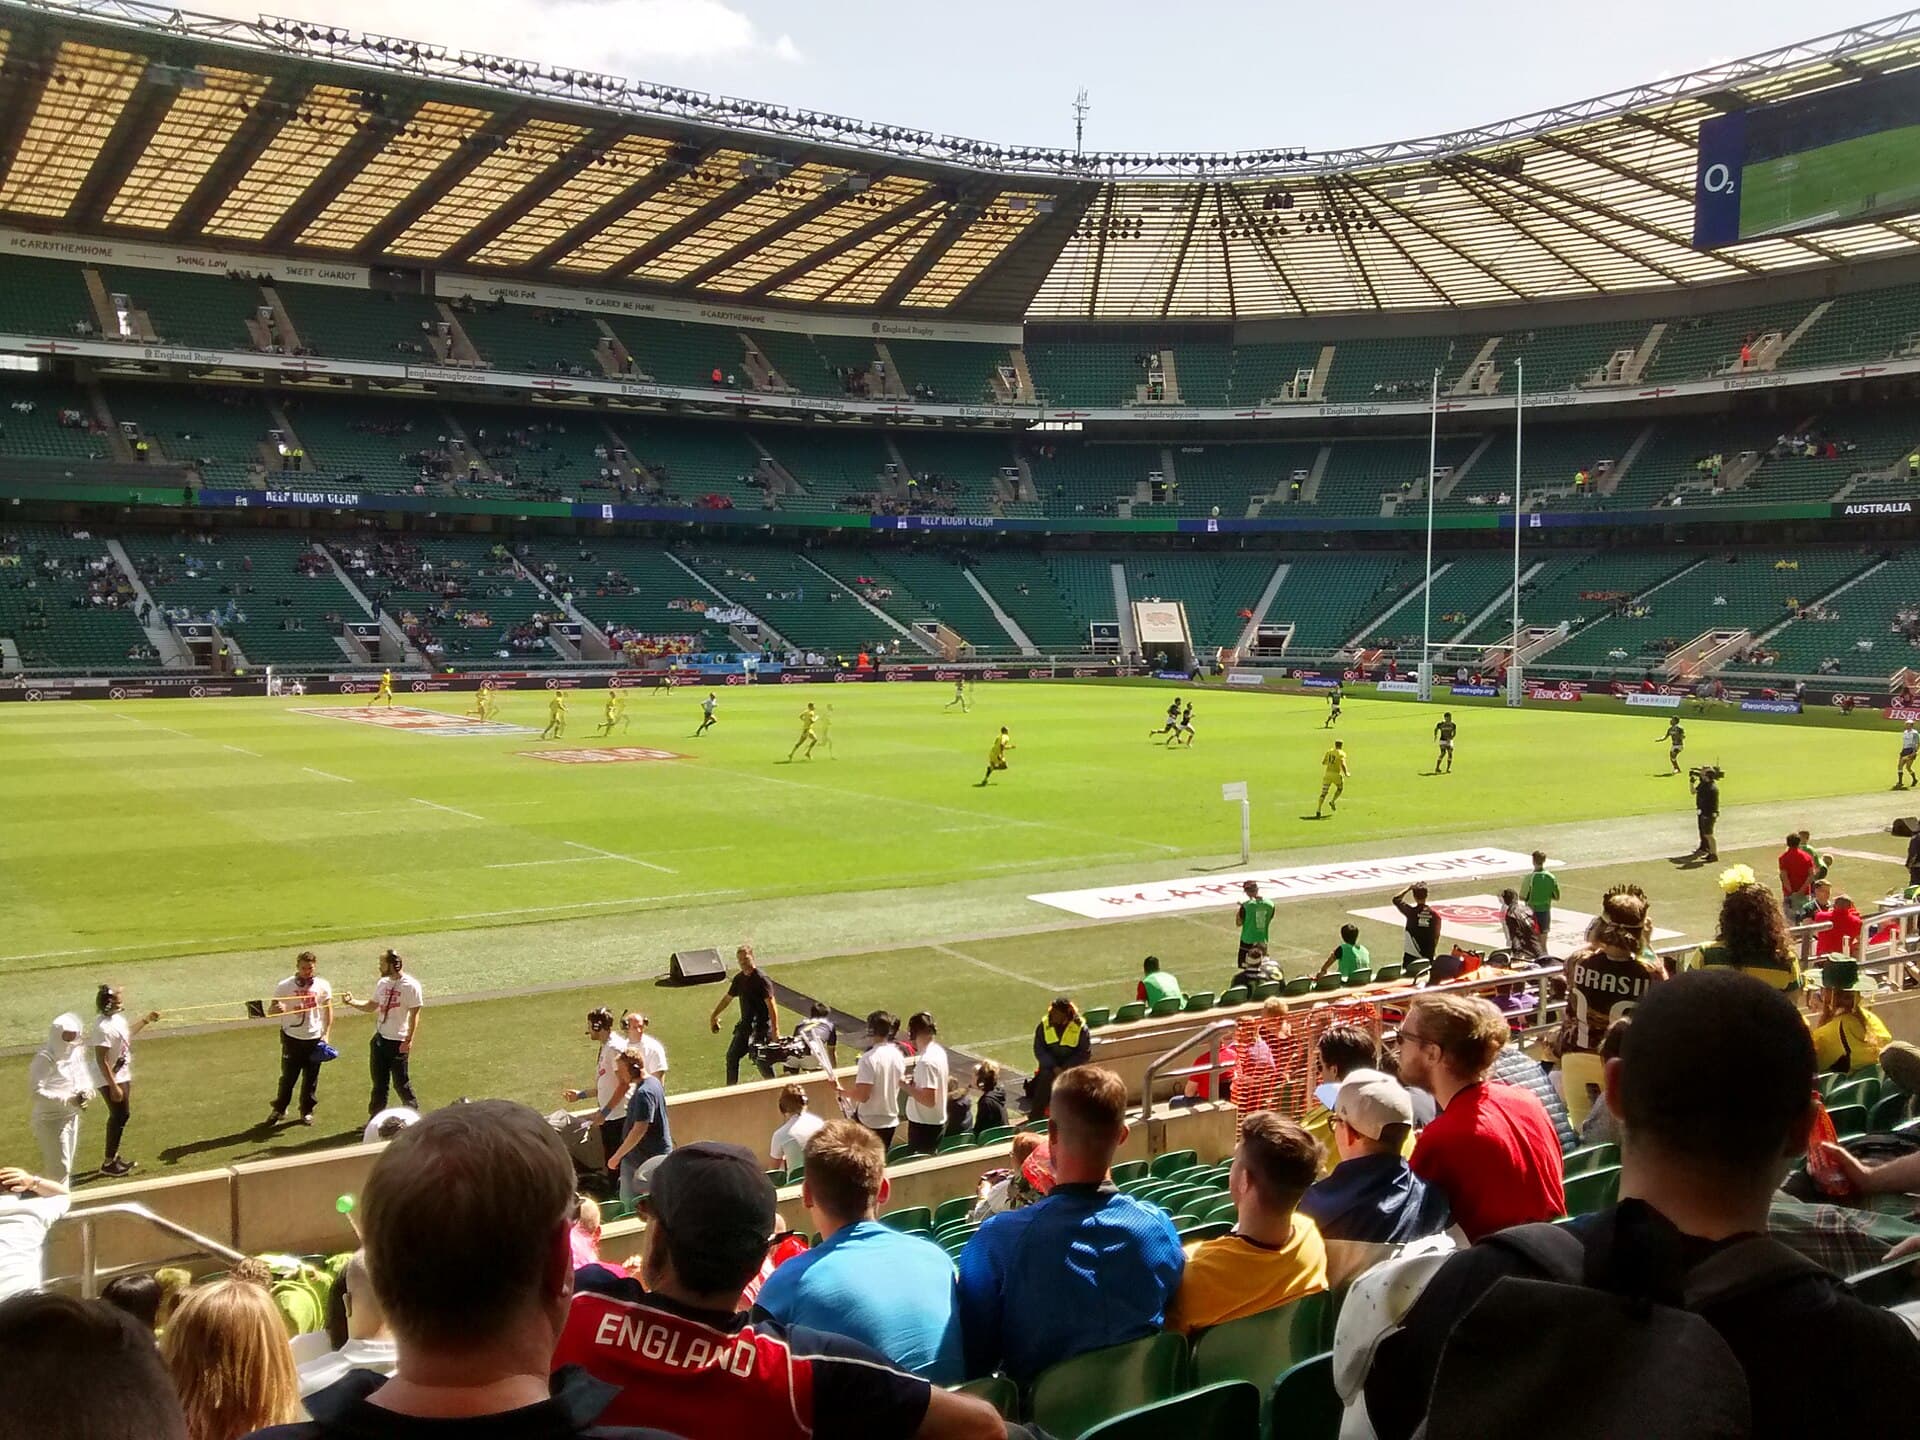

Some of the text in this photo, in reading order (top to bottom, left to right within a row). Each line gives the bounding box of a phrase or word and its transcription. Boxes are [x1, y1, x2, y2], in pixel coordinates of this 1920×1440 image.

[1704, 163, 1735, 195] O2
[10, 237, 113, 257] #CARRYTHEMHOME
[176, 255, 228, 269] SWING LOW
[286, 266, 357, 281] SWEET CHARIOT
[488, 287, 536, 299] COMING FOR
[882, 325, 934, 336] England Rugby
[154, 350, 224, 364] England Rugby
[409, 369, 486, 382] englandrugby.com
[628, 385, 658, 395] England
[1326, 405, 1381, 417] England Rugby
[1844, 502, 1912, 515] AUSTRALIA
[1533, 688, 1560, 699] HSBC
[1888, 709, 1920, 720] HSBC
[594, 1312, 757, 1378] ENGLAND
